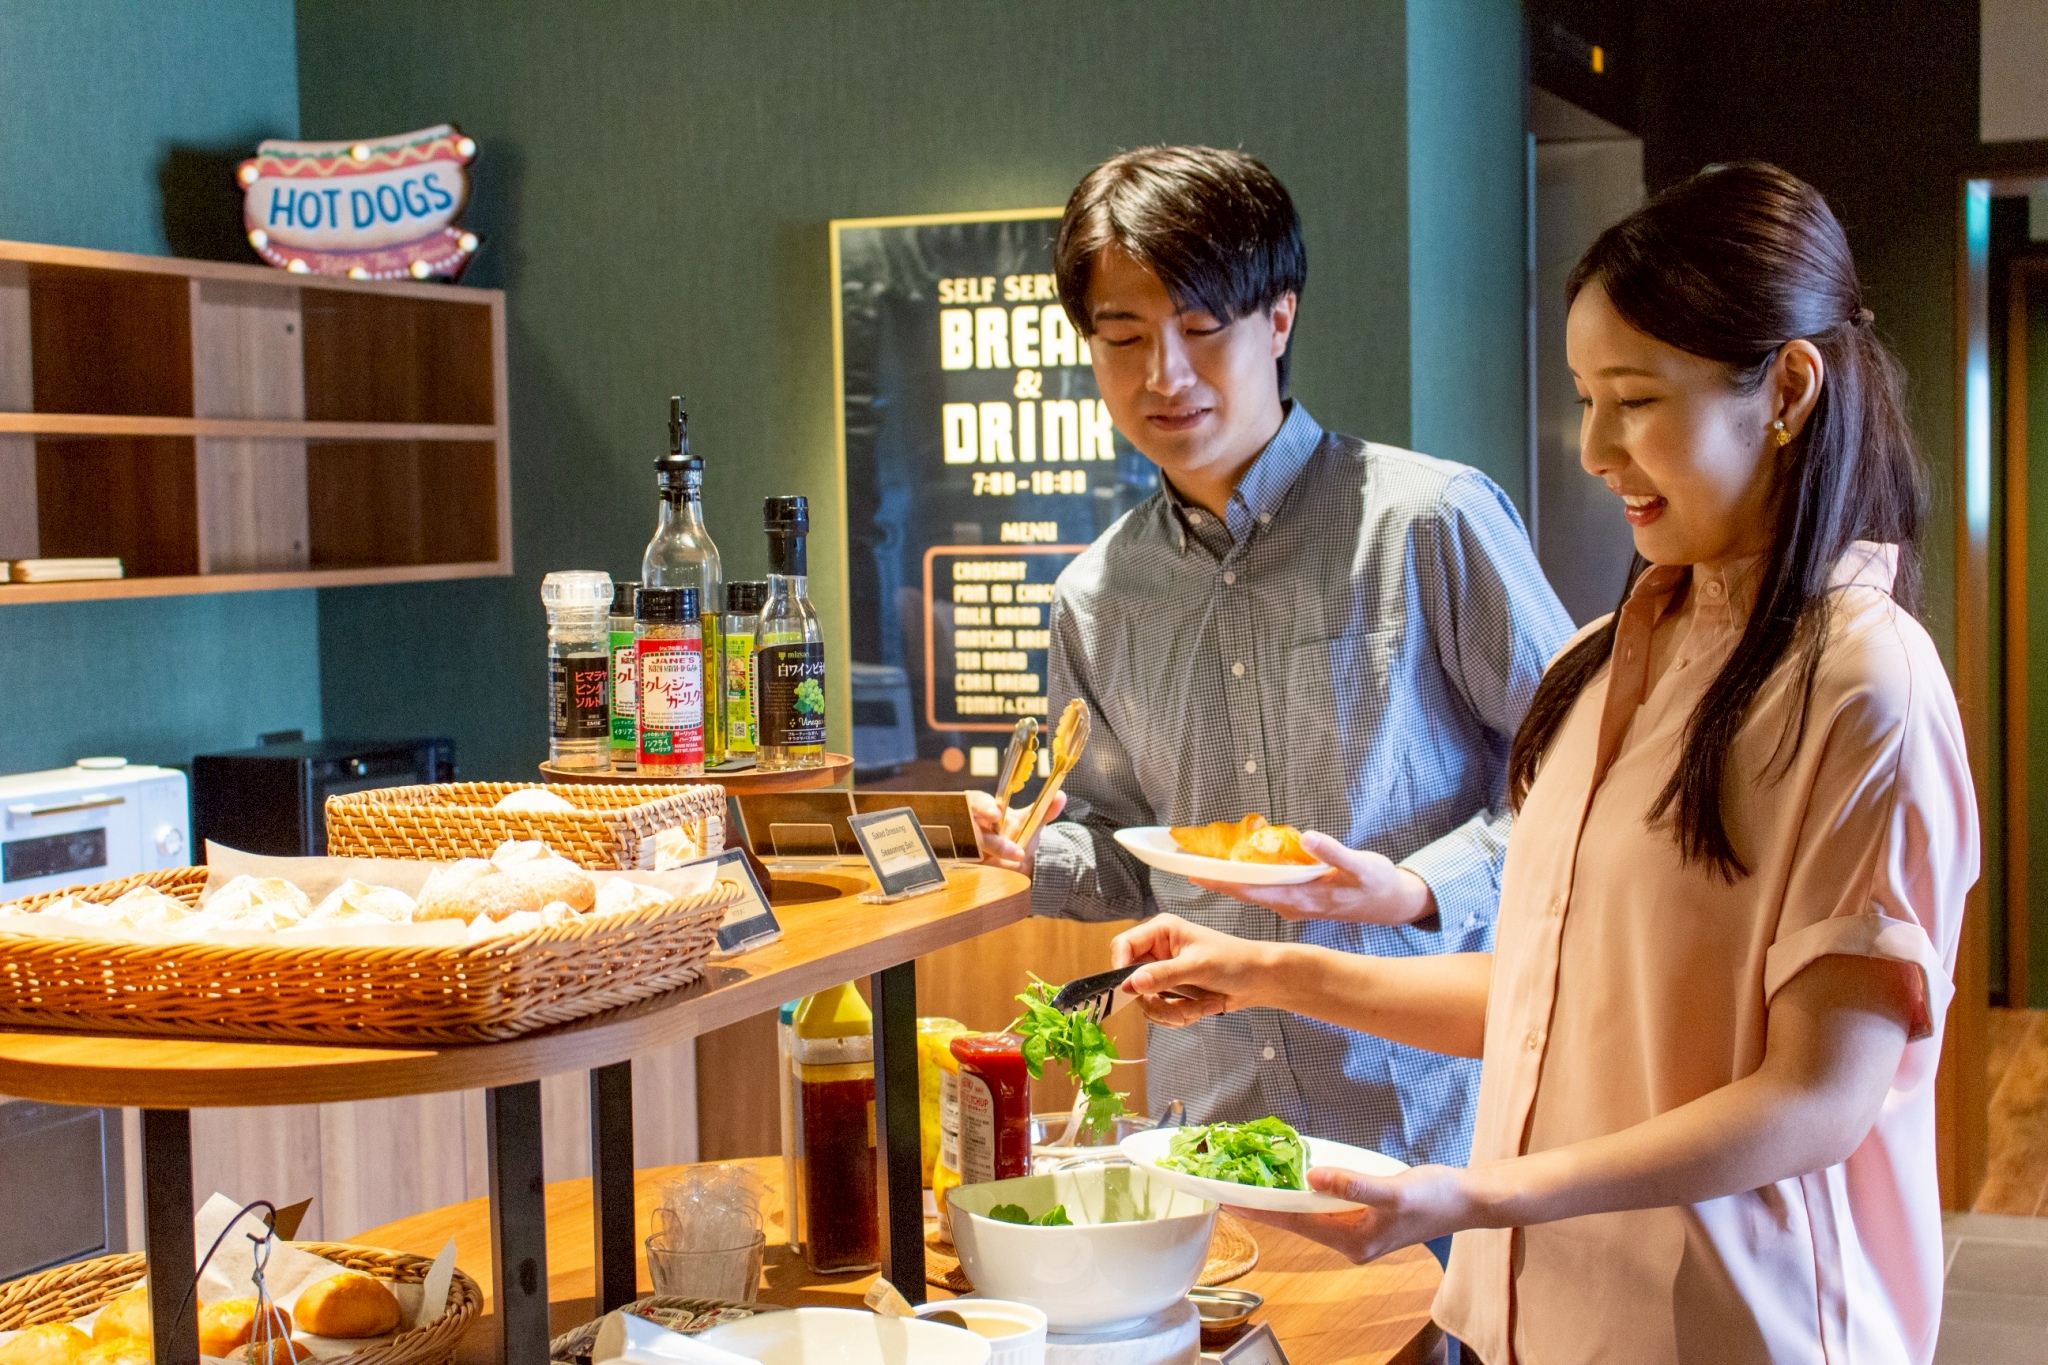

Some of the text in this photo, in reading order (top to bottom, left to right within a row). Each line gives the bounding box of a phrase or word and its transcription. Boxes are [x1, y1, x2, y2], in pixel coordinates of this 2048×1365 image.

[269, 173, 452, 229] HOT DOGS
[938, 277, 997, 304] SELF
[1013, 369, 1043, 399] &
[1000, 521, 1058, 542] MENU
[953, 561, 1027, 581] CROISSANT
[1016, 583, 1055, 603] CHOC
[651, 656, 695, 665] JANE'S
[575, 670, 608, 682] ヒマラヤ
[617, 667, 636, 684] クレ
[575, 683, 603, 695] ピンク
[645, 676, 694, 697] クレイジー
[575, 696, 601, 708] ソルト
[666, 690, 701, 709] ガーリック
[644, 738, 668, 748] ノンフライ
[881, 845, 905, 857] Seasoning
